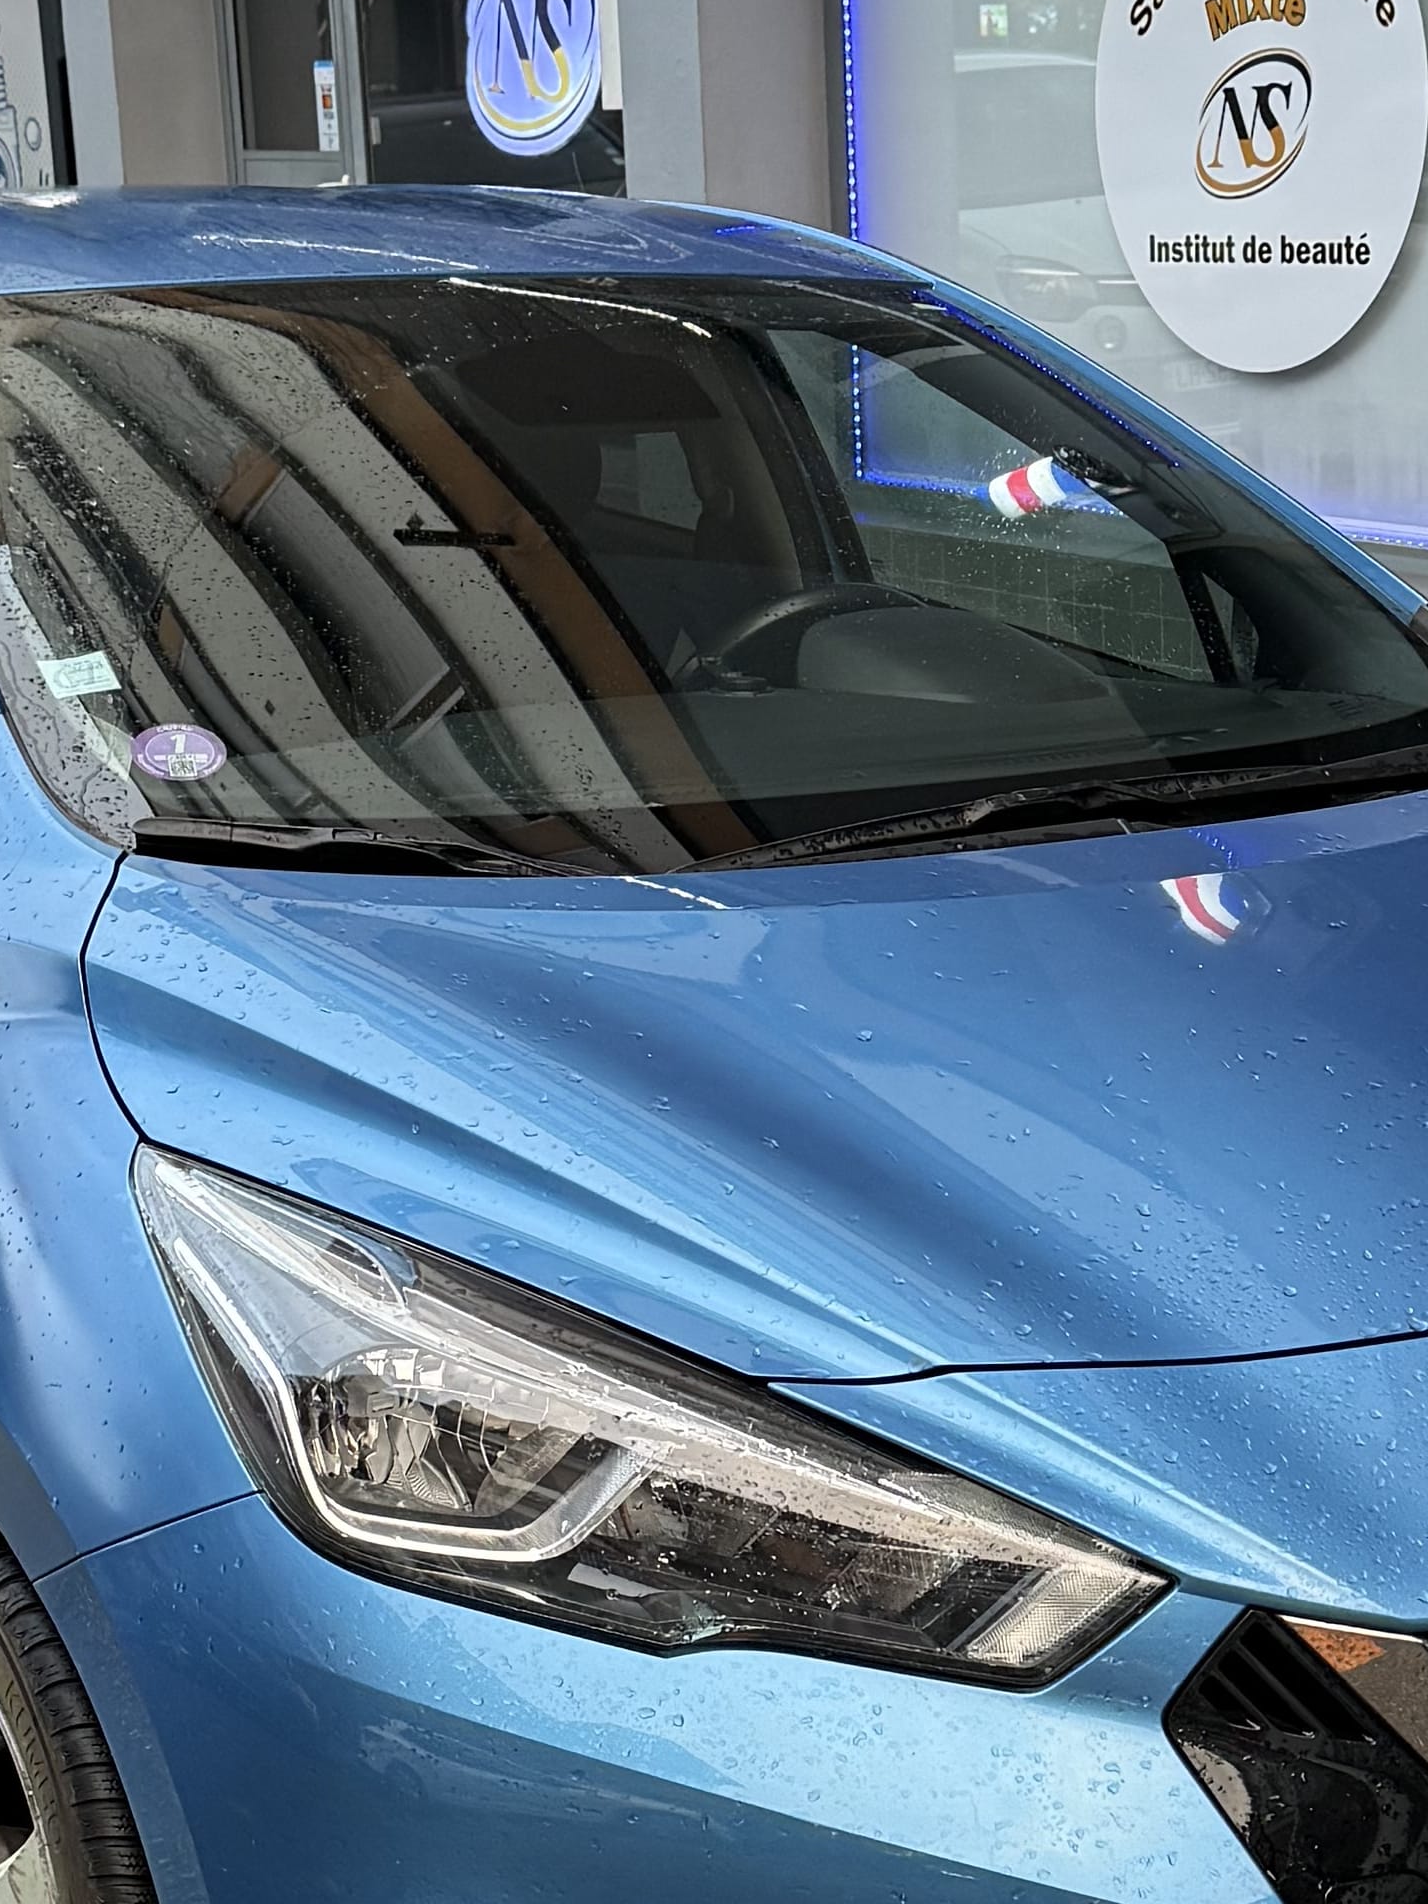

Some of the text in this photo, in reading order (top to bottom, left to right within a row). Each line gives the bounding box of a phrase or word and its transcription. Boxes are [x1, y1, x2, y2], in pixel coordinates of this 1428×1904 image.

[1149, 232, 1372, 266] Institut de beauté
[170, 734, 186, 753] 1
